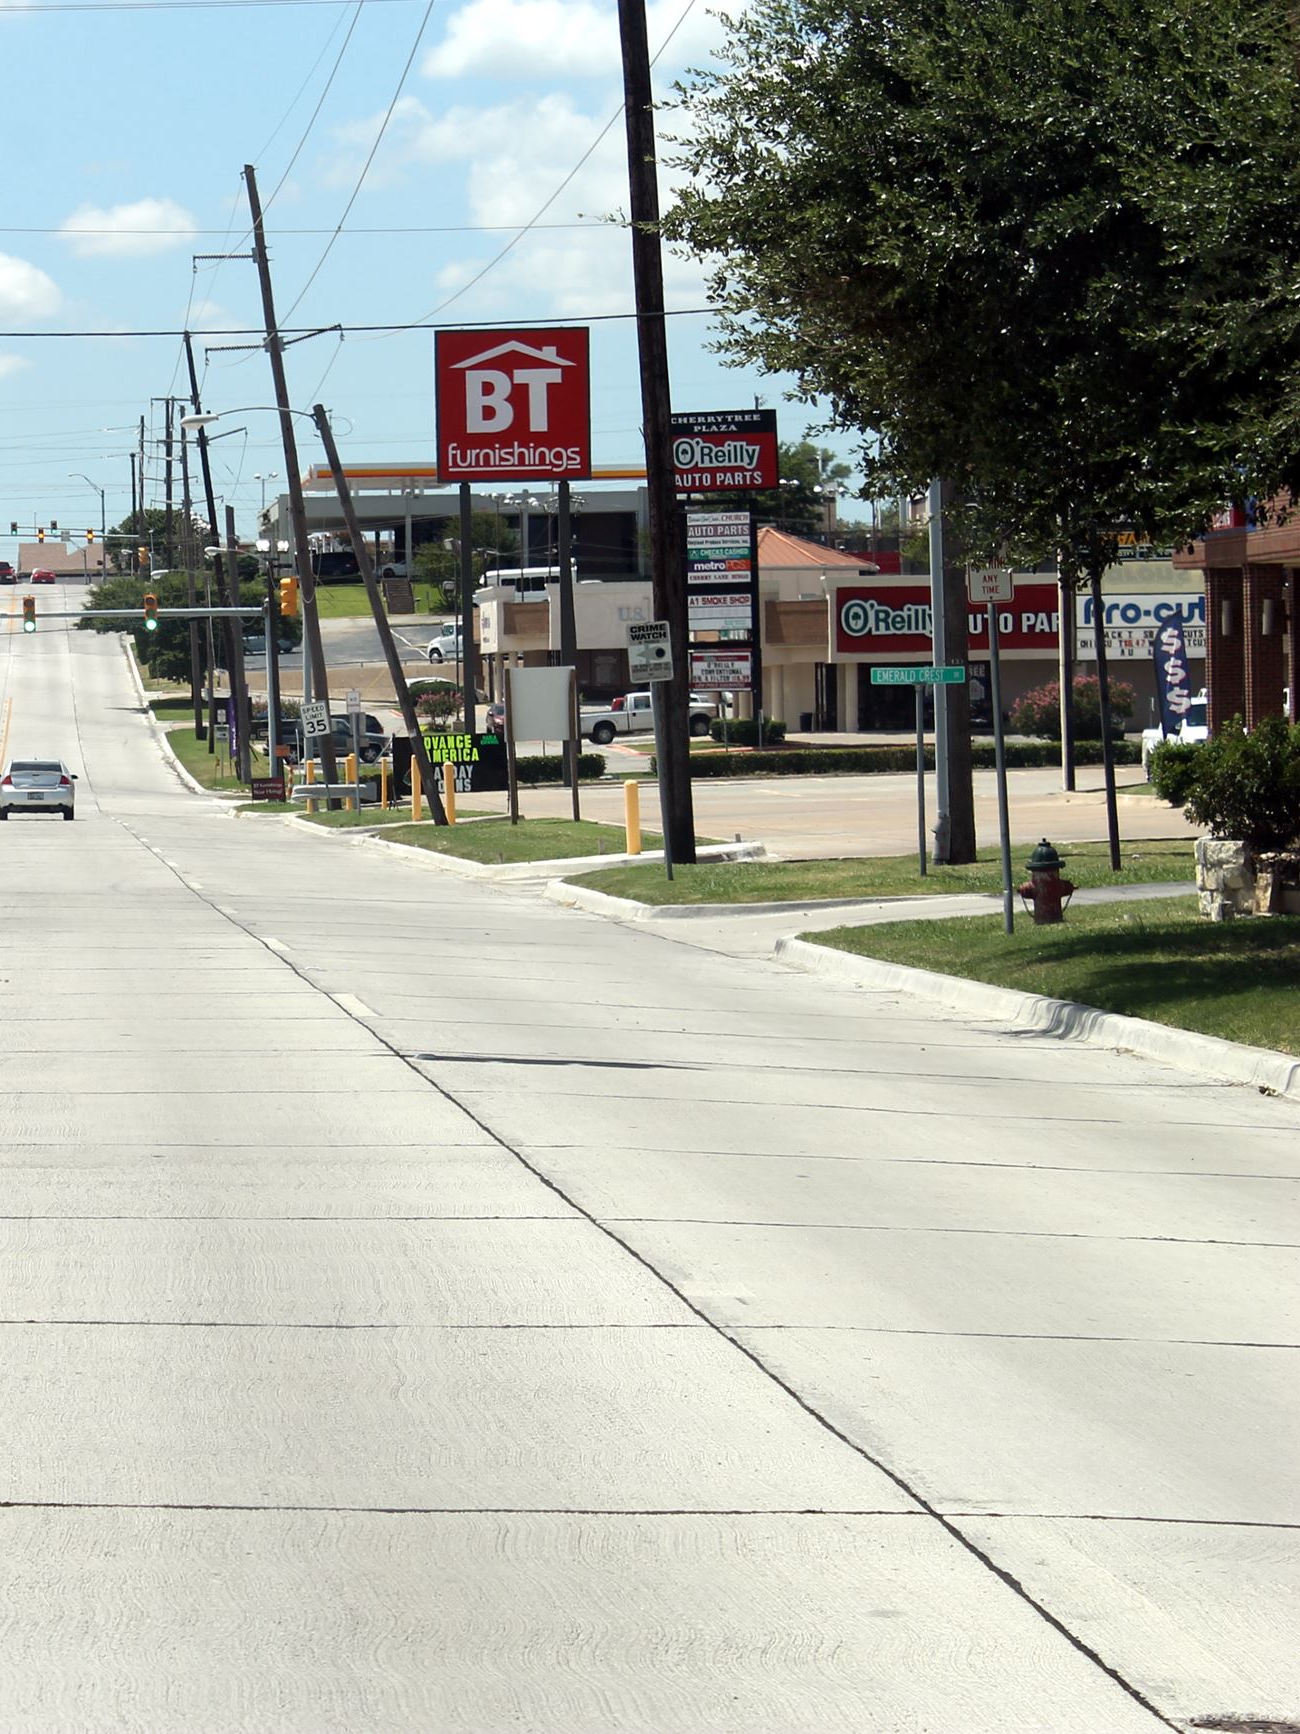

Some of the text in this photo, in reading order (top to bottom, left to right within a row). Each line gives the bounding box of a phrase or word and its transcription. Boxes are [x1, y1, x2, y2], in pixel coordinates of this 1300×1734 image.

[465, 368, 562, 434] BT
[693, 424, 738, 432] PLAZA
[448, 441, 581, 472] furnishings
[673, 438, 759, 469] O'Reilly
[675, 471, 762, 487] AUTO PARTS
[688, 525, 750, 537] AUTO PARTS
[982, 574, 998, 583] ANY
[982, 585, 1000, 595] TIME
[701, 596, 728, 605] SMOKE
[729, 595, 750, 604] SHOP
[630, 624, 667, 634] CRIME
[630, 632, 667, 641] WATCH
[876, 670, 916, 682] EMERALD
[919, 670, 945, 681] CREST
[302, 705, 325, 714] SPEED
[306, 719, 327, 734] 35
[423, 734, 472, 750] DVANCE
